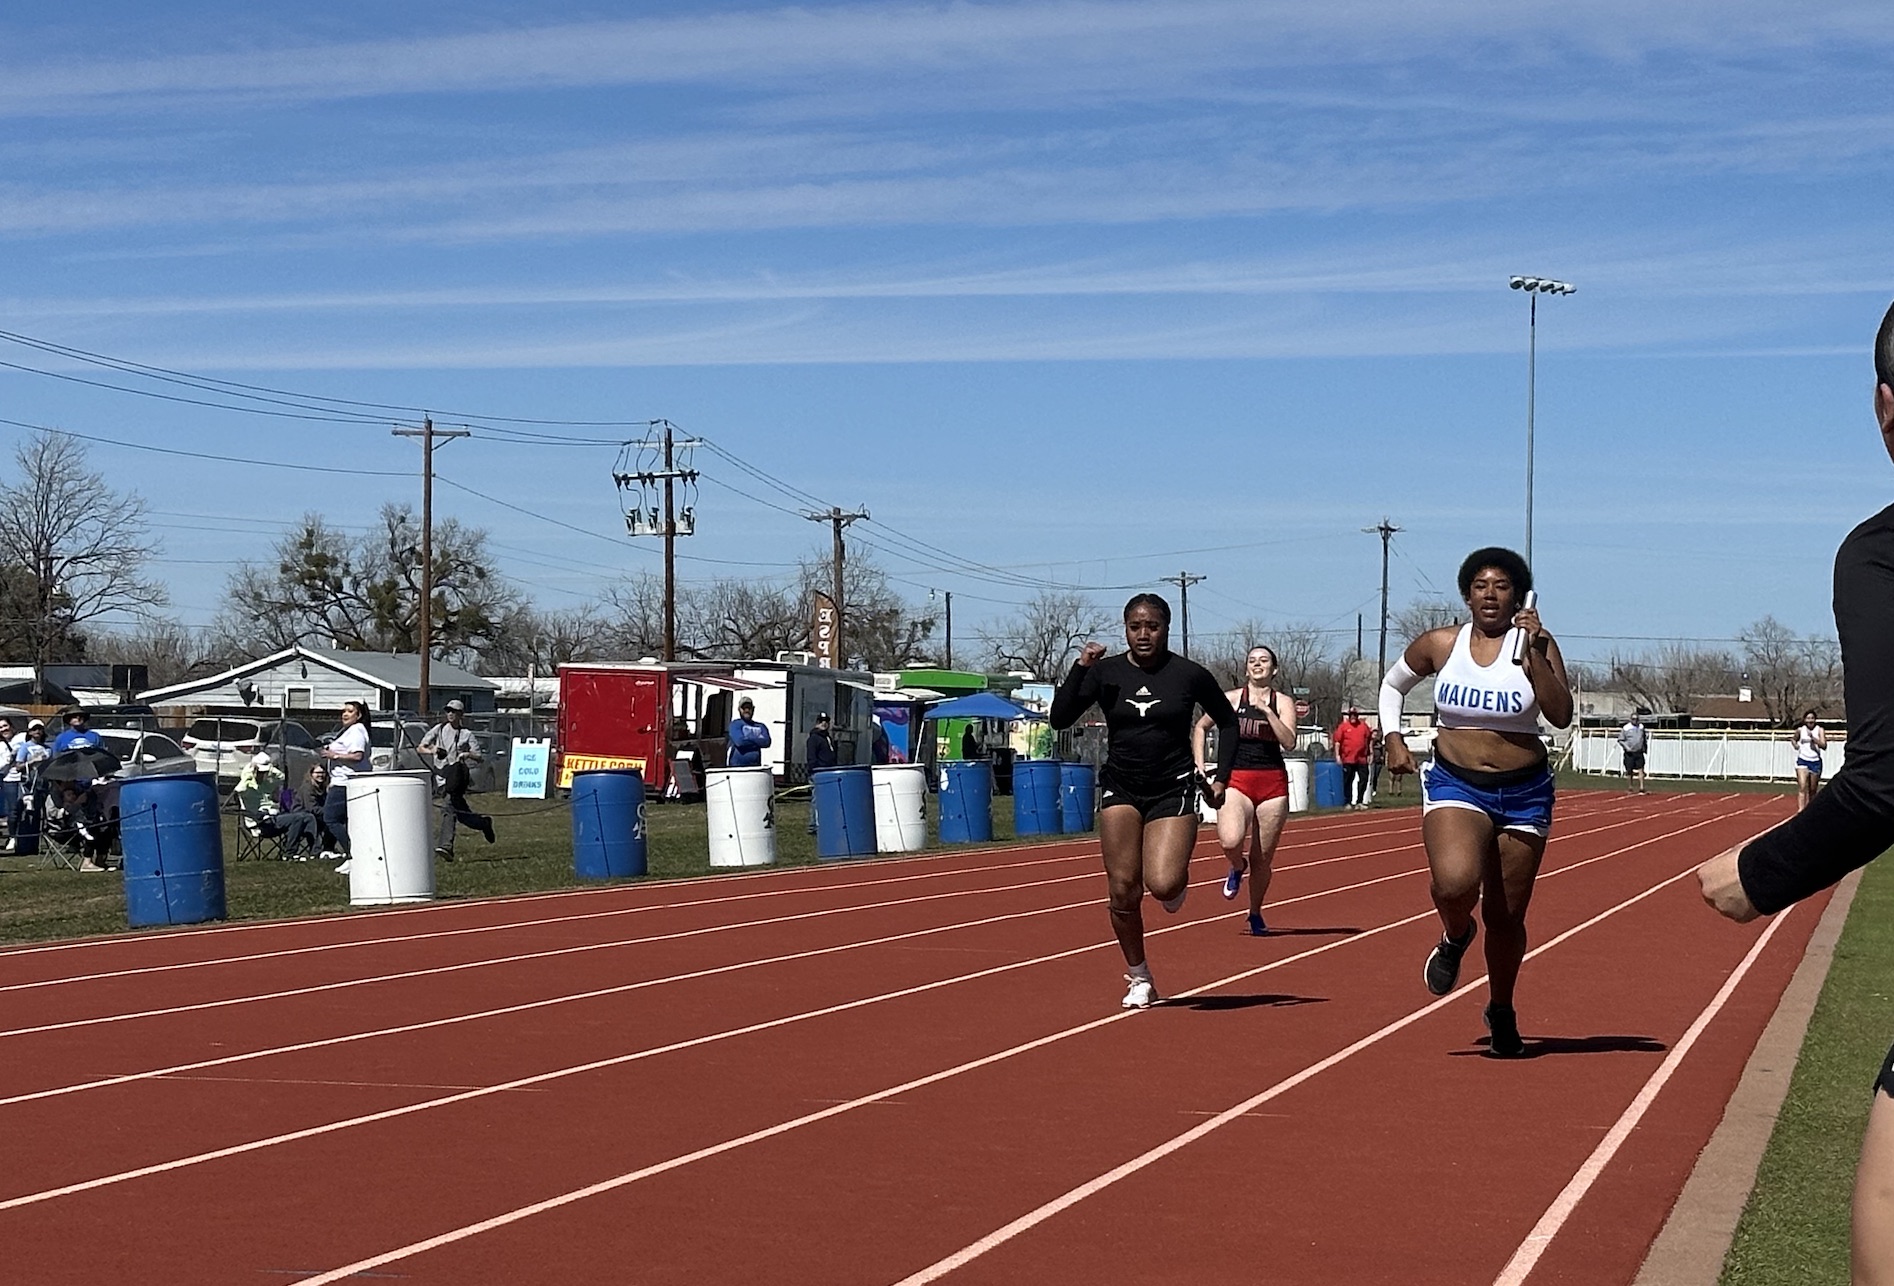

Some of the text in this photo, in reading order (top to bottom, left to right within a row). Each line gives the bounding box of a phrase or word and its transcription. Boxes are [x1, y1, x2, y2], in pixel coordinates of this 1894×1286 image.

[1437, 682, 1523, 714] MAIDENS
[523, 754, 537, 762] ICE
[566, 758, 607, 769] KETTLE
[518, 767, 540, 776] COLD
[512, 780, 542, 789] DRINKS
